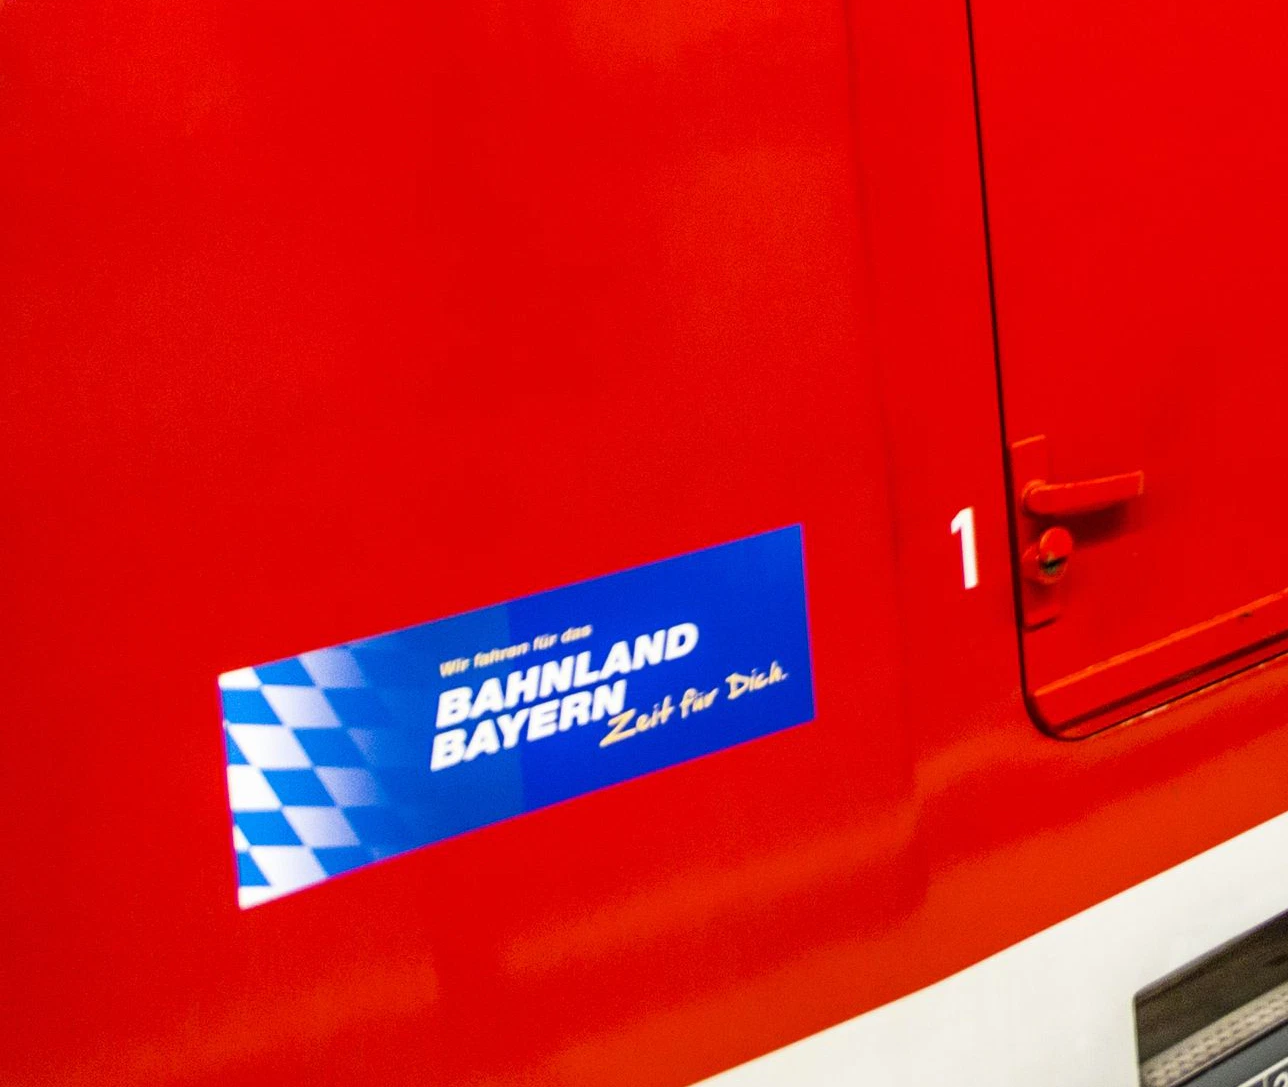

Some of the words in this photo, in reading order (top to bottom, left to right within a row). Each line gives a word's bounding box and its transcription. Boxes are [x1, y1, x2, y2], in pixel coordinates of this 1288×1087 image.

[950, 506, 979, 590] 1
[436, 622, 699, 729] BAHNLAND
[439, 657, 470, 678] Wir
[473, 640, 529, 669] fahren
[532, 631, 558, 652] für
[561, 624, 593, 644] das
[430, 679, 628, 772] BAYERN
[599, 694, 674, 749] Zeit
[679, 685, 719, 720] für
